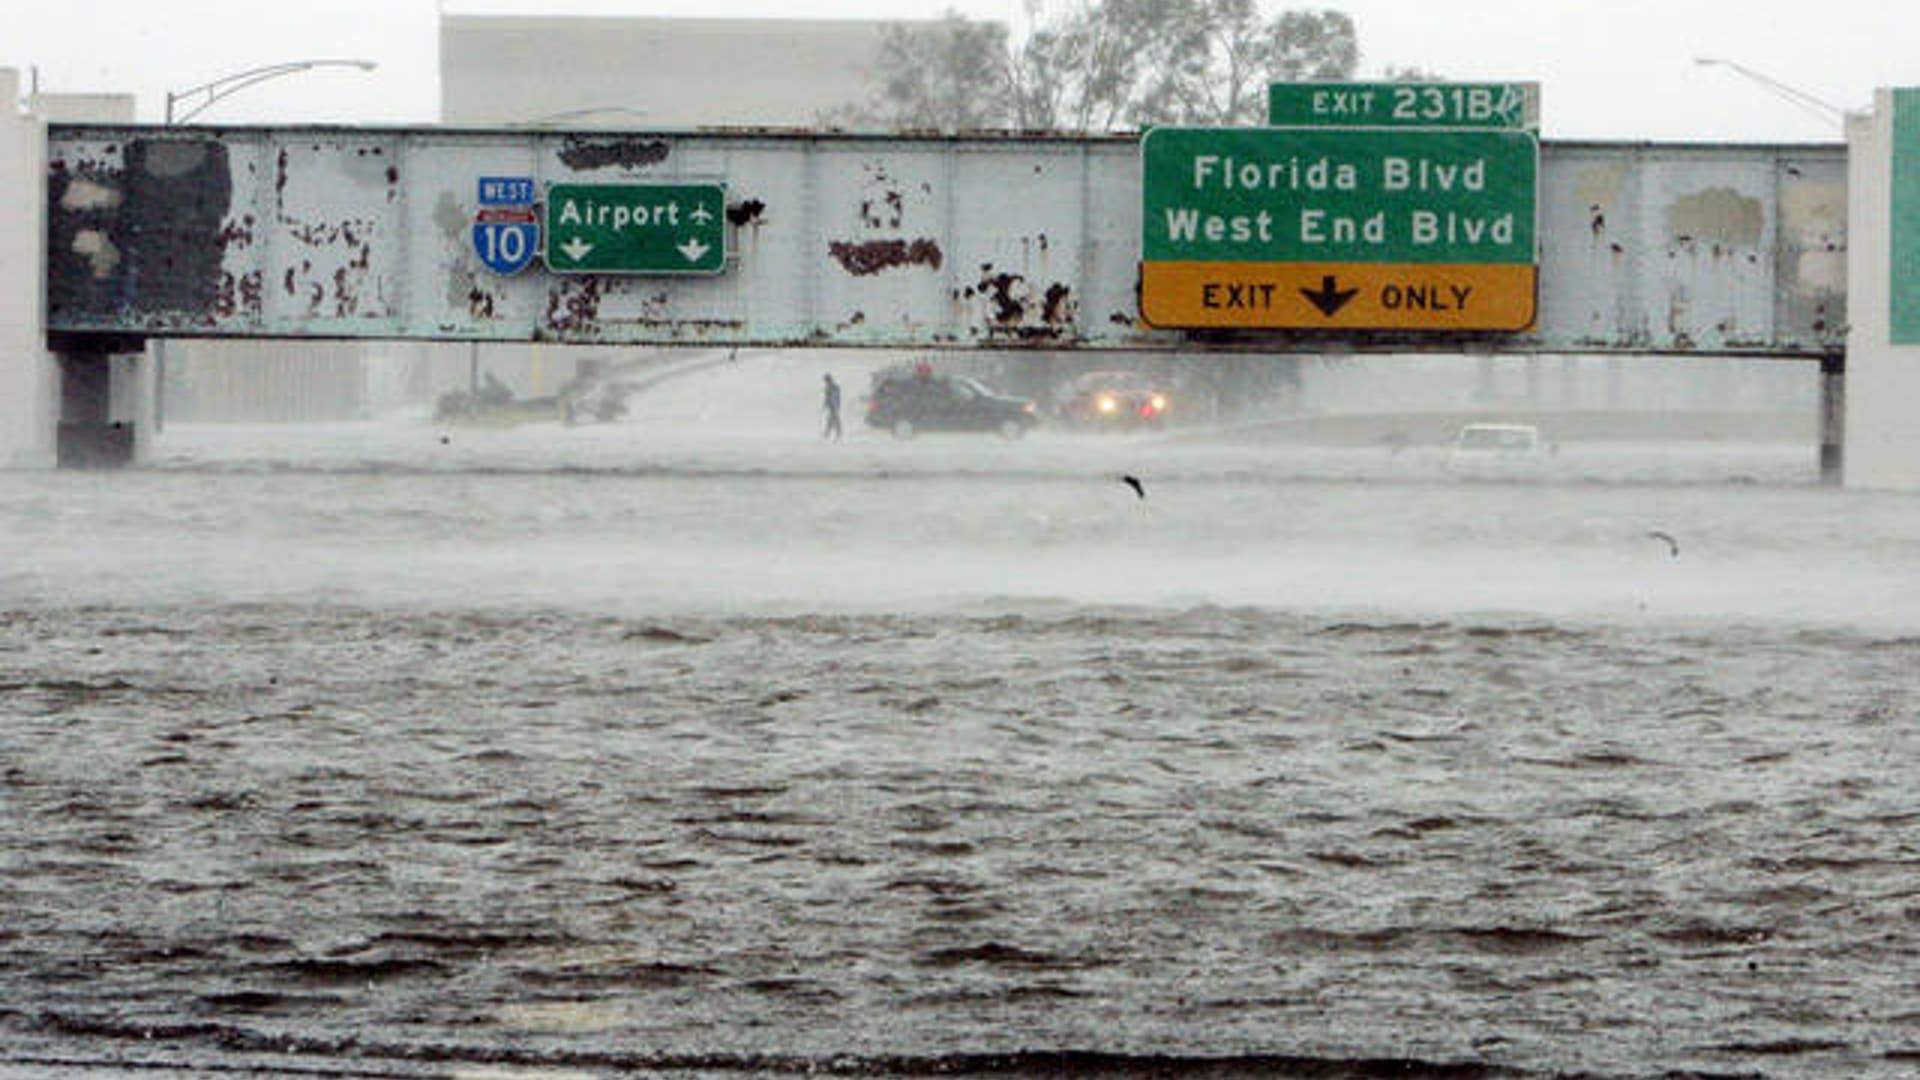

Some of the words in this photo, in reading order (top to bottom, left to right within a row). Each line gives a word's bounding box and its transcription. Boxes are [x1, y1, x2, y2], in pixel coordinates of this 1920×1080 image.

[1313, 92, 1374, 114] EXIT
[1193, 155, 1358, 190] Florida
[1383, 157, 1486, 191] Blvd
[484, 182, 528, 200] WEST
[559, 200, 680, 231] Airport
[1165, 208, 1274, 243] West
[1300, 209, 1385, 244] End
[1412, 210, 1514, 245] Blvd
[485, 225, 526, 263] 10
[1202, 284, 1277, 310] EXIT
[1381, 284, 1474, 311] ONLY
